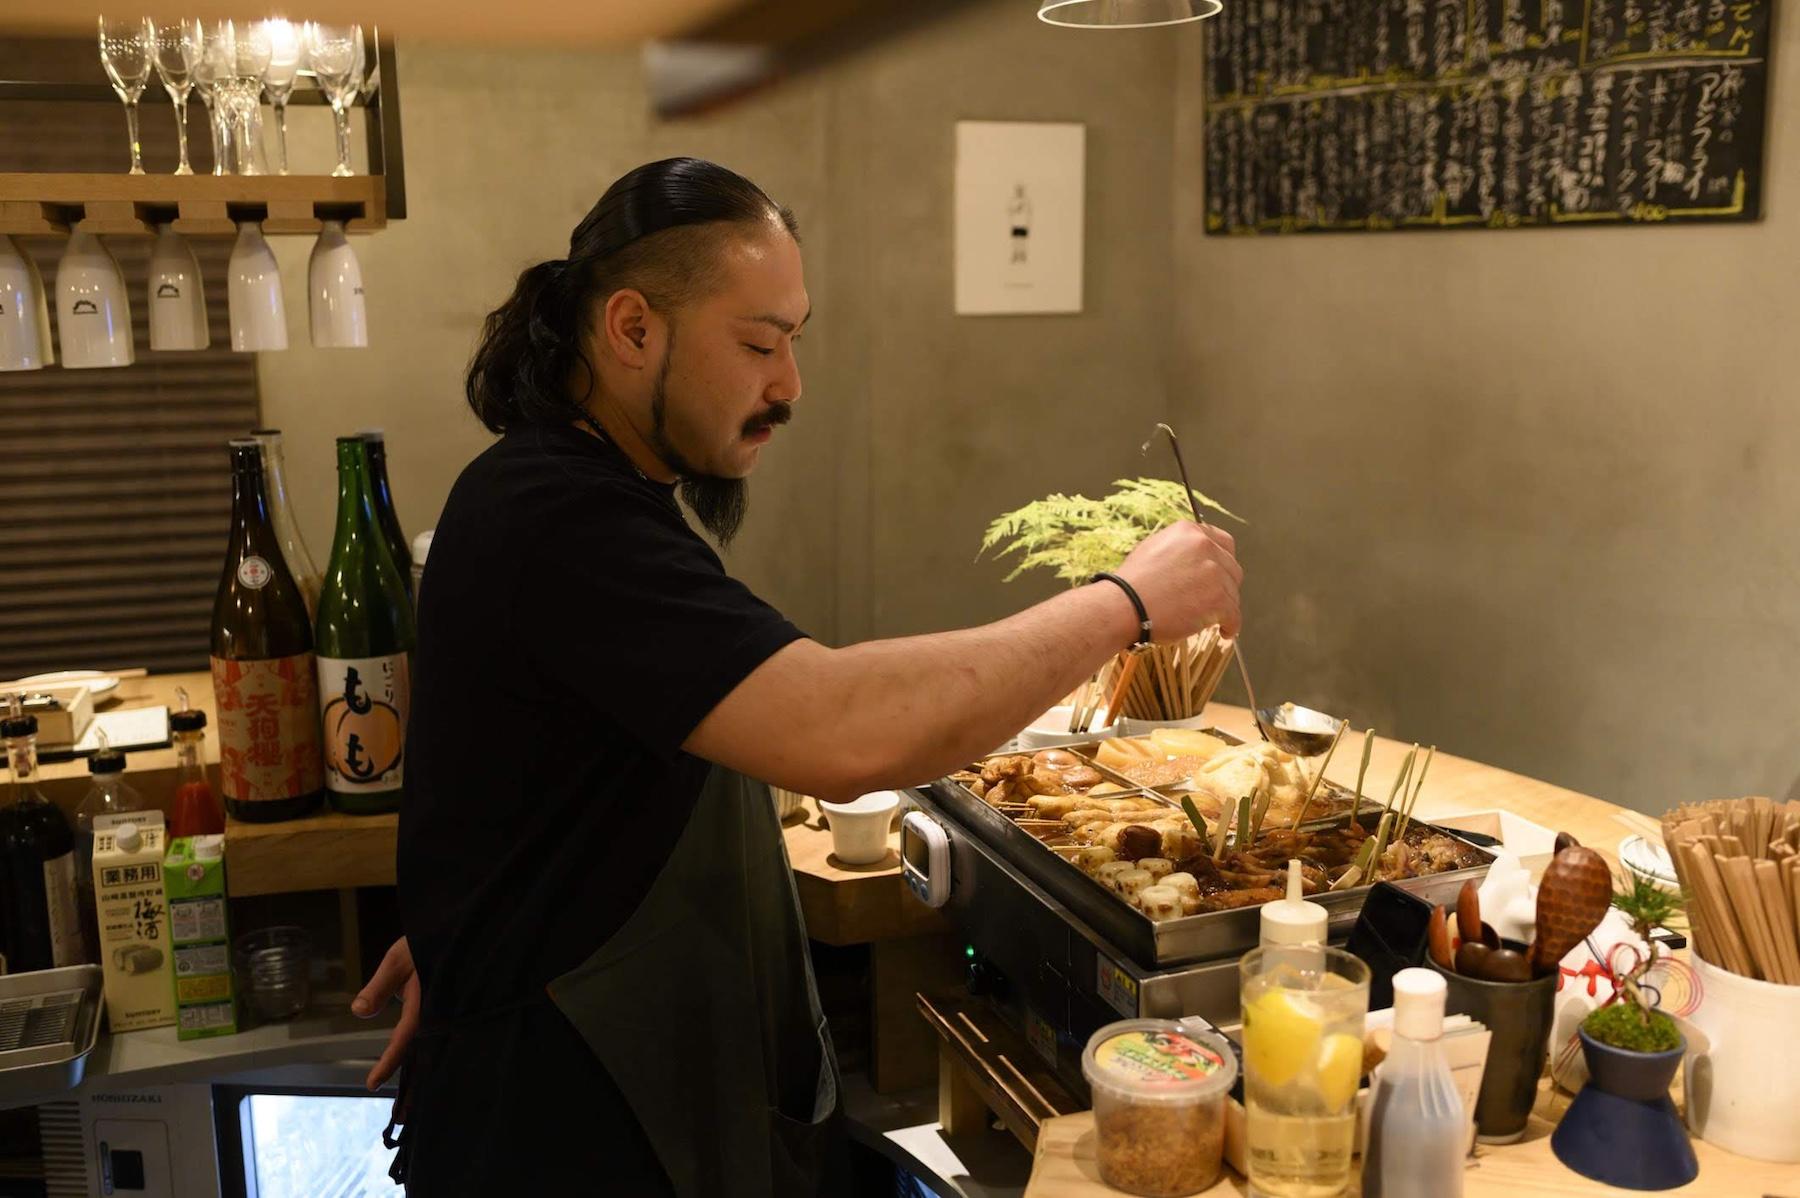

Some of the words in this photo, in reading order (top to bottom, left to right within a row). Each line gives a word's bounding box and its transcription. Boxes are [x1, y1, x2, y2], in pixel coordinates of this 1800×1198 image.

[344, 666, 375, 777] もも
[104, 865, 157, 885] 業務用
[134, 900, 166, 940] 梅酒
